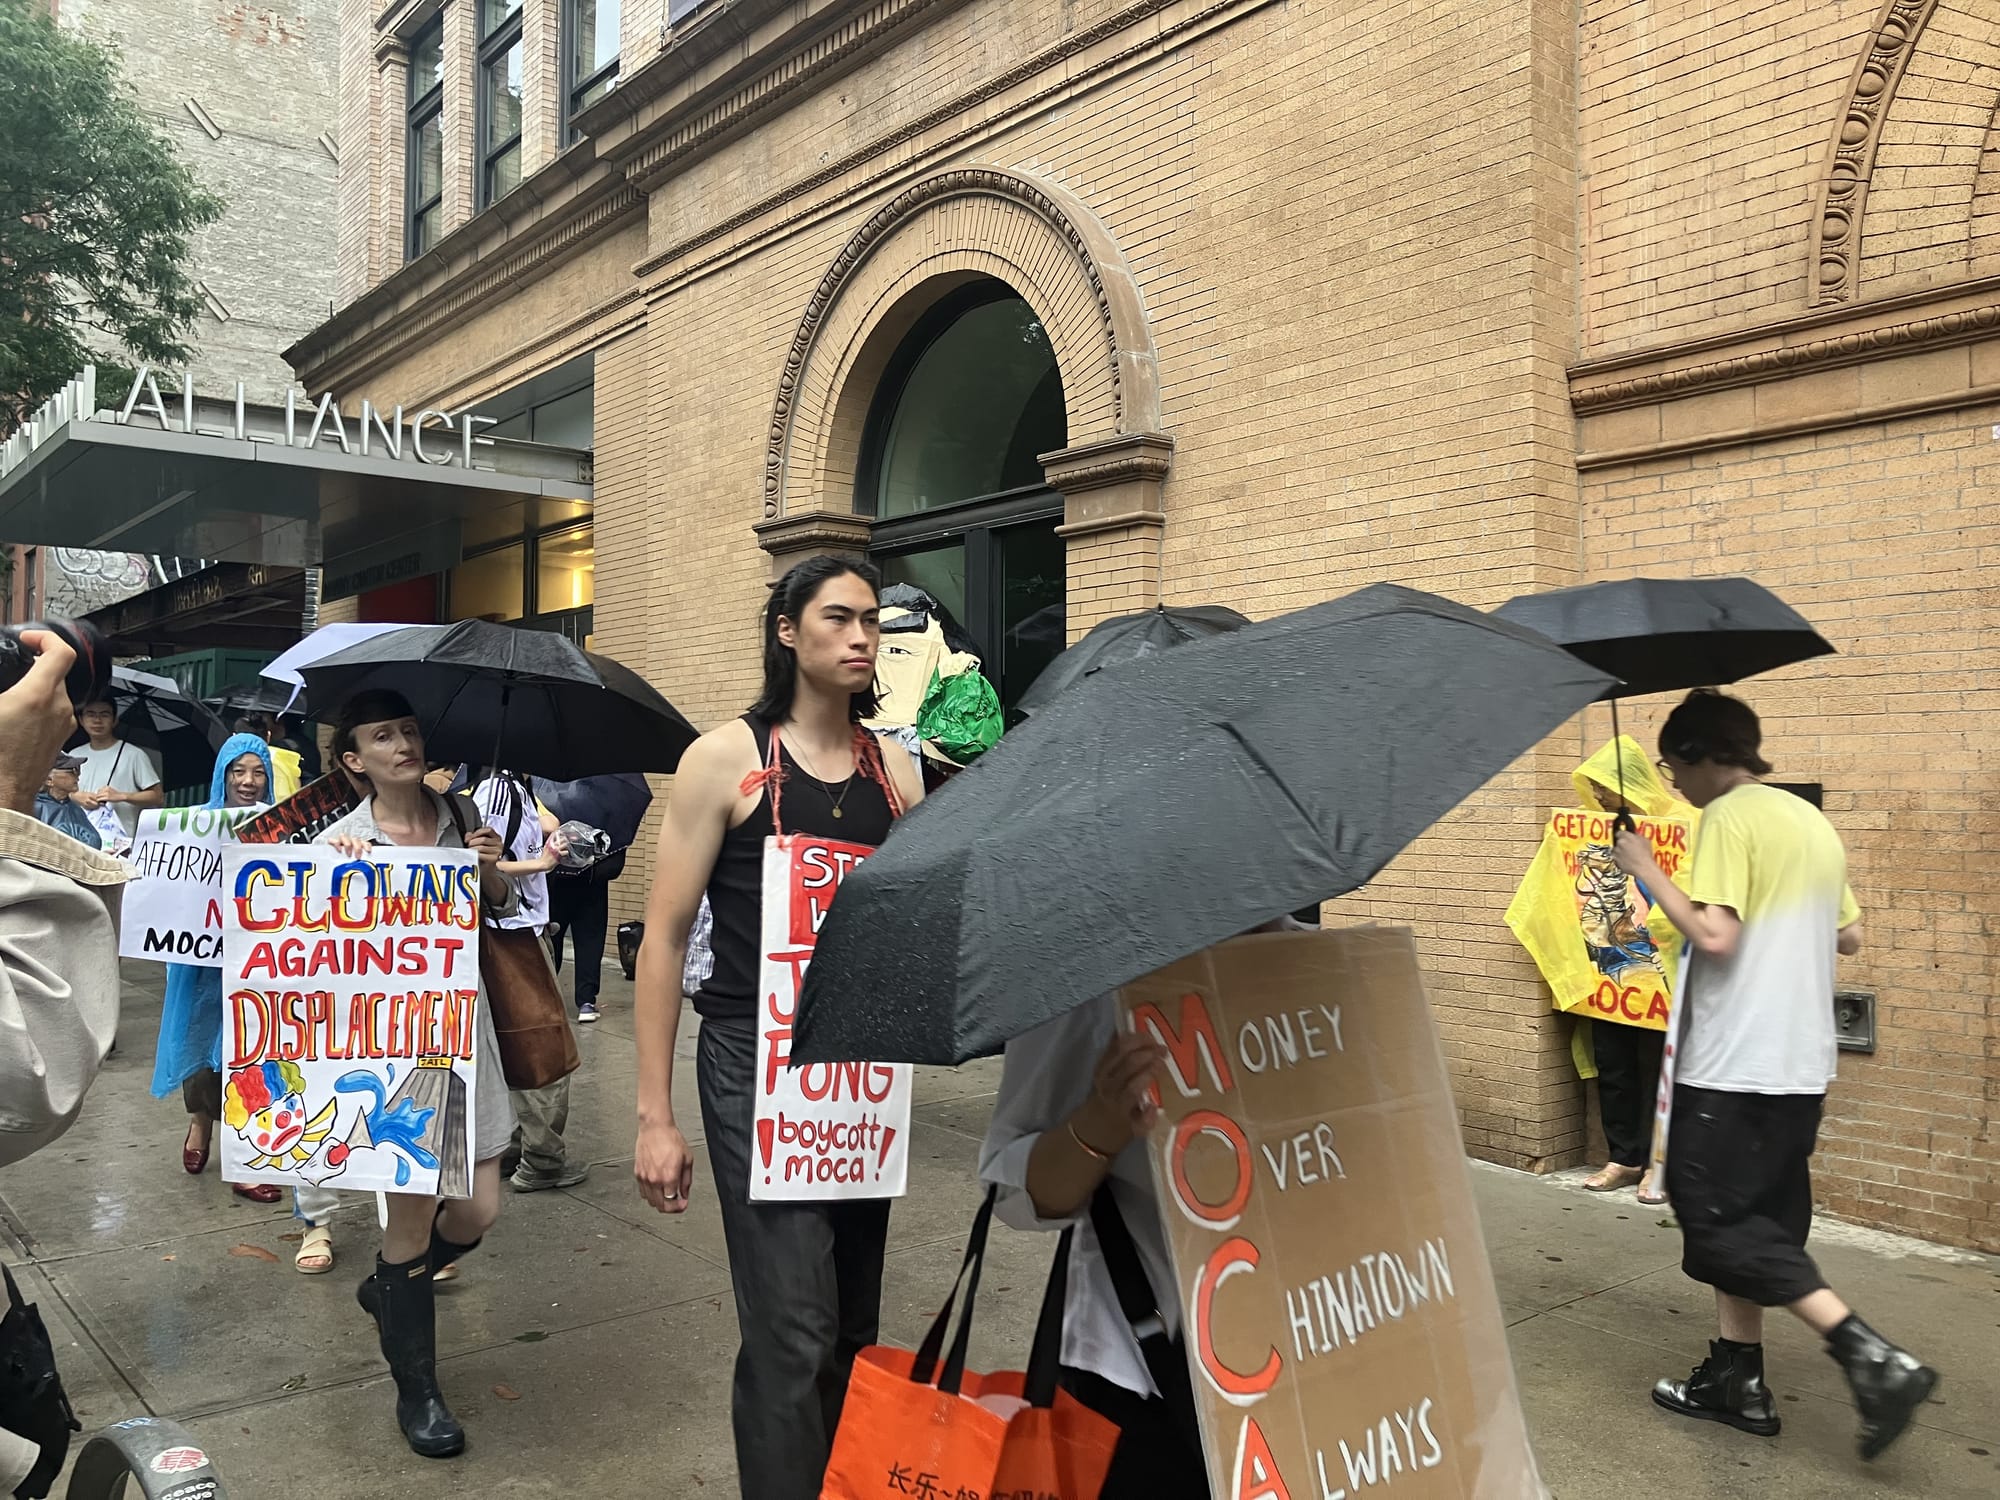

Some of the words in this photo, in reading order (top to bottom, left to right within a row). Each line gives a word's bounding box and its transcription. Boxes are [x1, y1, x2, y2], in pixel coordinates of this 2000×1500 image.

[118, 366, 499, 472] ALLIANCE
[158, 807, 258, 840] MON
[1553, 812, 1587, 839] GET
[1590, 818, 1613, 840] OF
[134, 840, 223, 888] AFFORDA
[233, 859, 480, 933] CLOWNS
[240, 936, 464, 979] AGAINST
[1584, 977, 1669, 1019] OCA
[228, 988, 478, 1069] DISPLACEMENT
